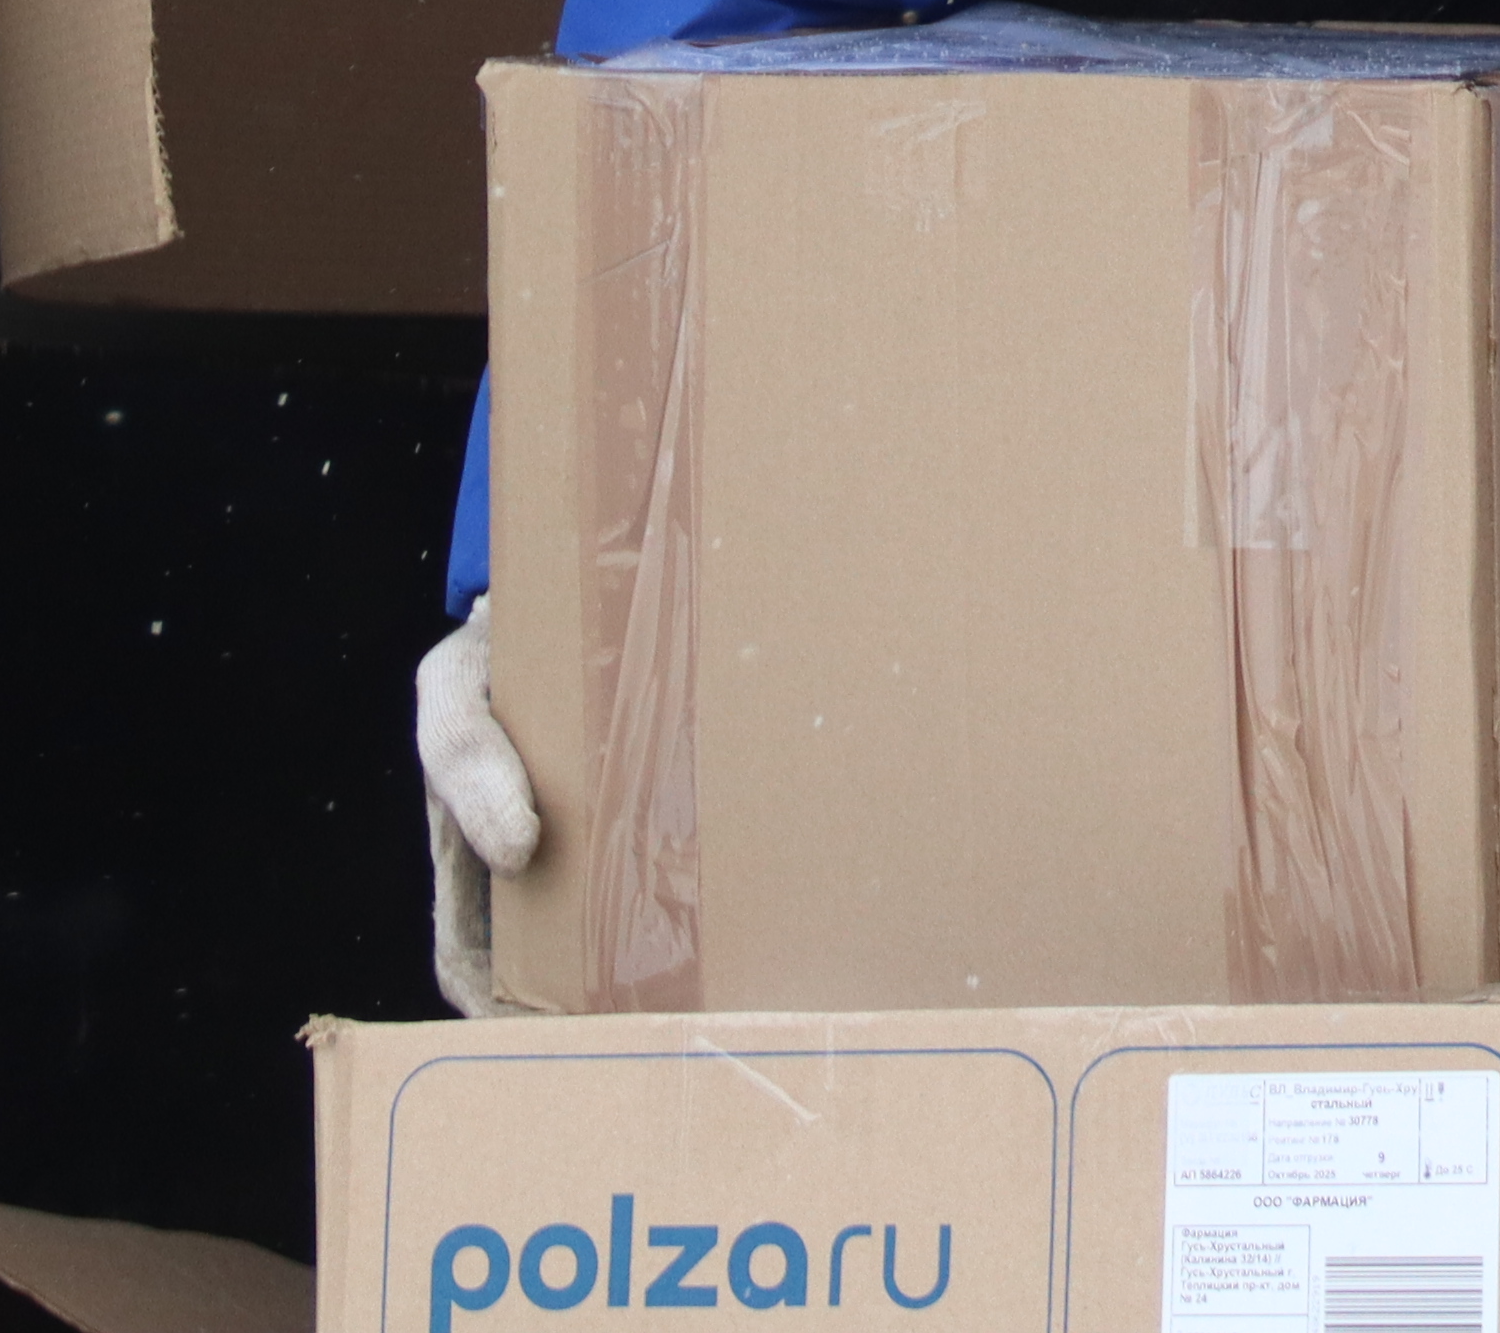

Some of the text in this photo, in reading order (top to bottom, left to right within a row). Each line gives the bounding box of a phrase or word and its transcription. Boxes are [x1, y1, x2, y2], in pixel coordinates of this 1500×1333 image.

[1310, 1097, 1373, 1110] стальный
[1377, 1151, 1386, 1164] 9
[1313, 1169, 1337, 1180] 2025
[1252, 1195, 1374, 1210] ООО "ФАРМАЦИЯ"
[1180, 1227, 1239, 1241] Фармация
[1180, 1240, 1286, 1253] Гусь-Хрустальный
[1180, 1266, 1285, 1279] Гусь-Хрустальный
[1180, 1280, 1240, 1292] Теплицкий
[1277, 1281, 1300, 1292] дом
[1195, 1293, 1208, 1304] 24
